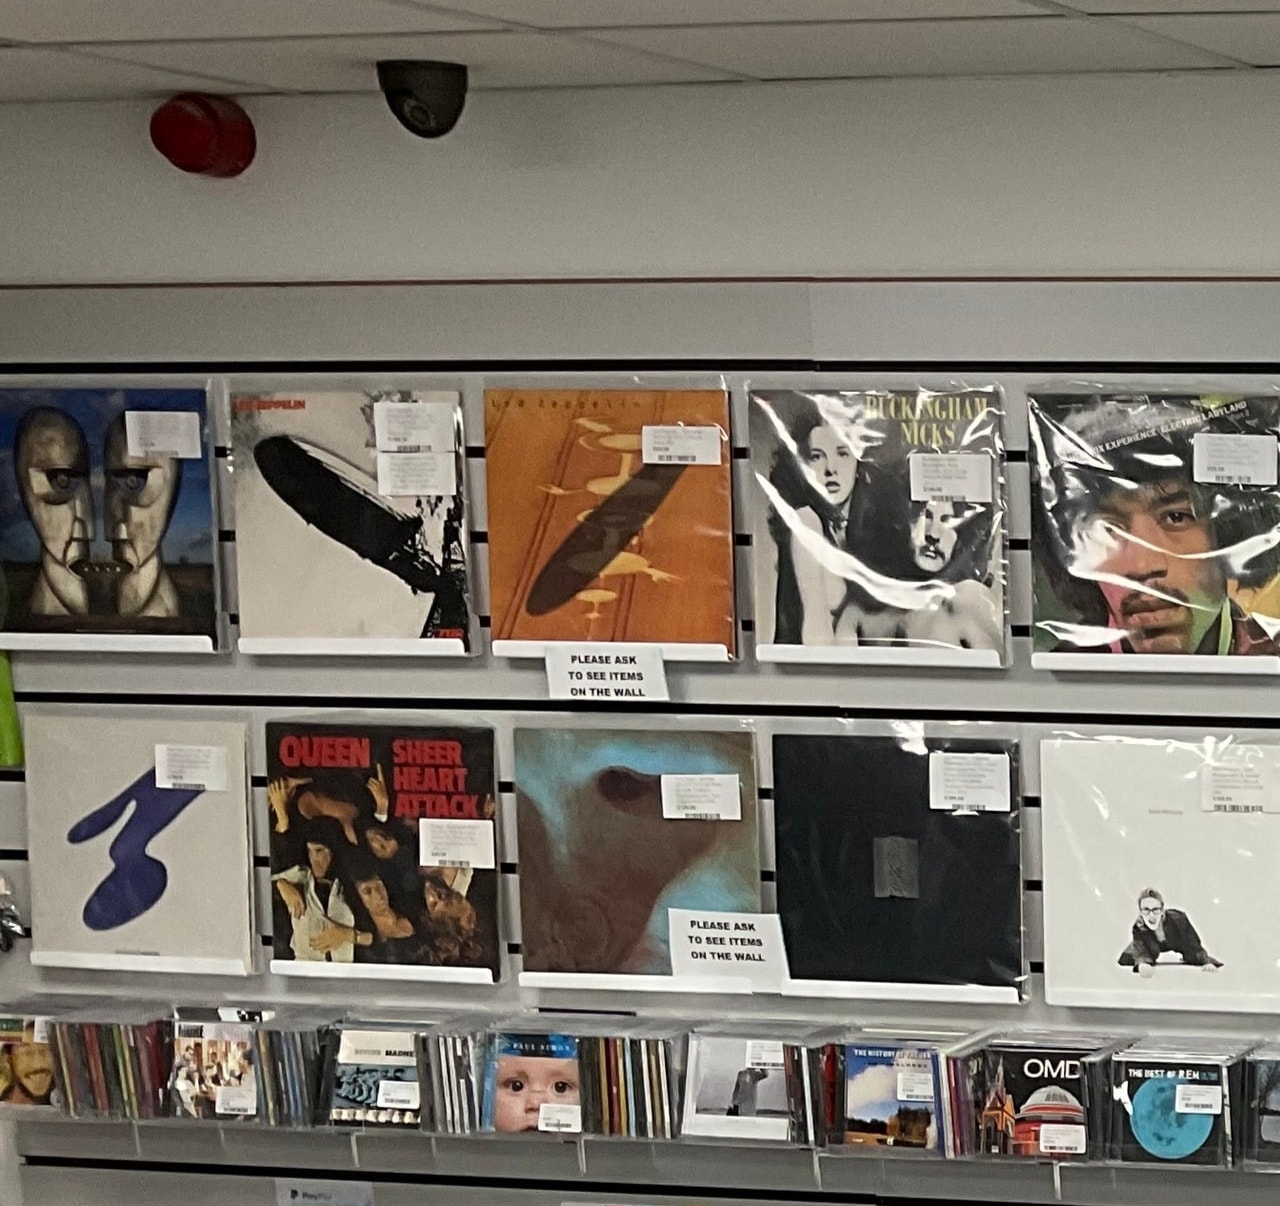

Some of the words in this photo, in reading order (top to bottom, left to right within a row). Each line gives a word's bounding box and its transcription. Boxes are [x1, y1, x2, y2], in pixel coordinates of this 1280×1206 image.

[901, 422, 955, 446] NICKS
[280, 736, 370, 768] QUEEN
[393, 741, 462, 767] SHEER
[393, 767, 468, 793] HEART
[393, 794, 480, 818] ATTACK
[690, 920, 731, 930] PLEASE
[734, 922, 756, 931] ASK
[688, 936, 702, 944] TO
[706, 937, 726, 945] SEE
[730, 937, 763, 946] ITEMS
[691, 951, 706, 960] ON
[710, 952, 732, 960] THE
[734, 952, 766, 962] WALL
[1023, 1058, 1081, 1079] OMD
